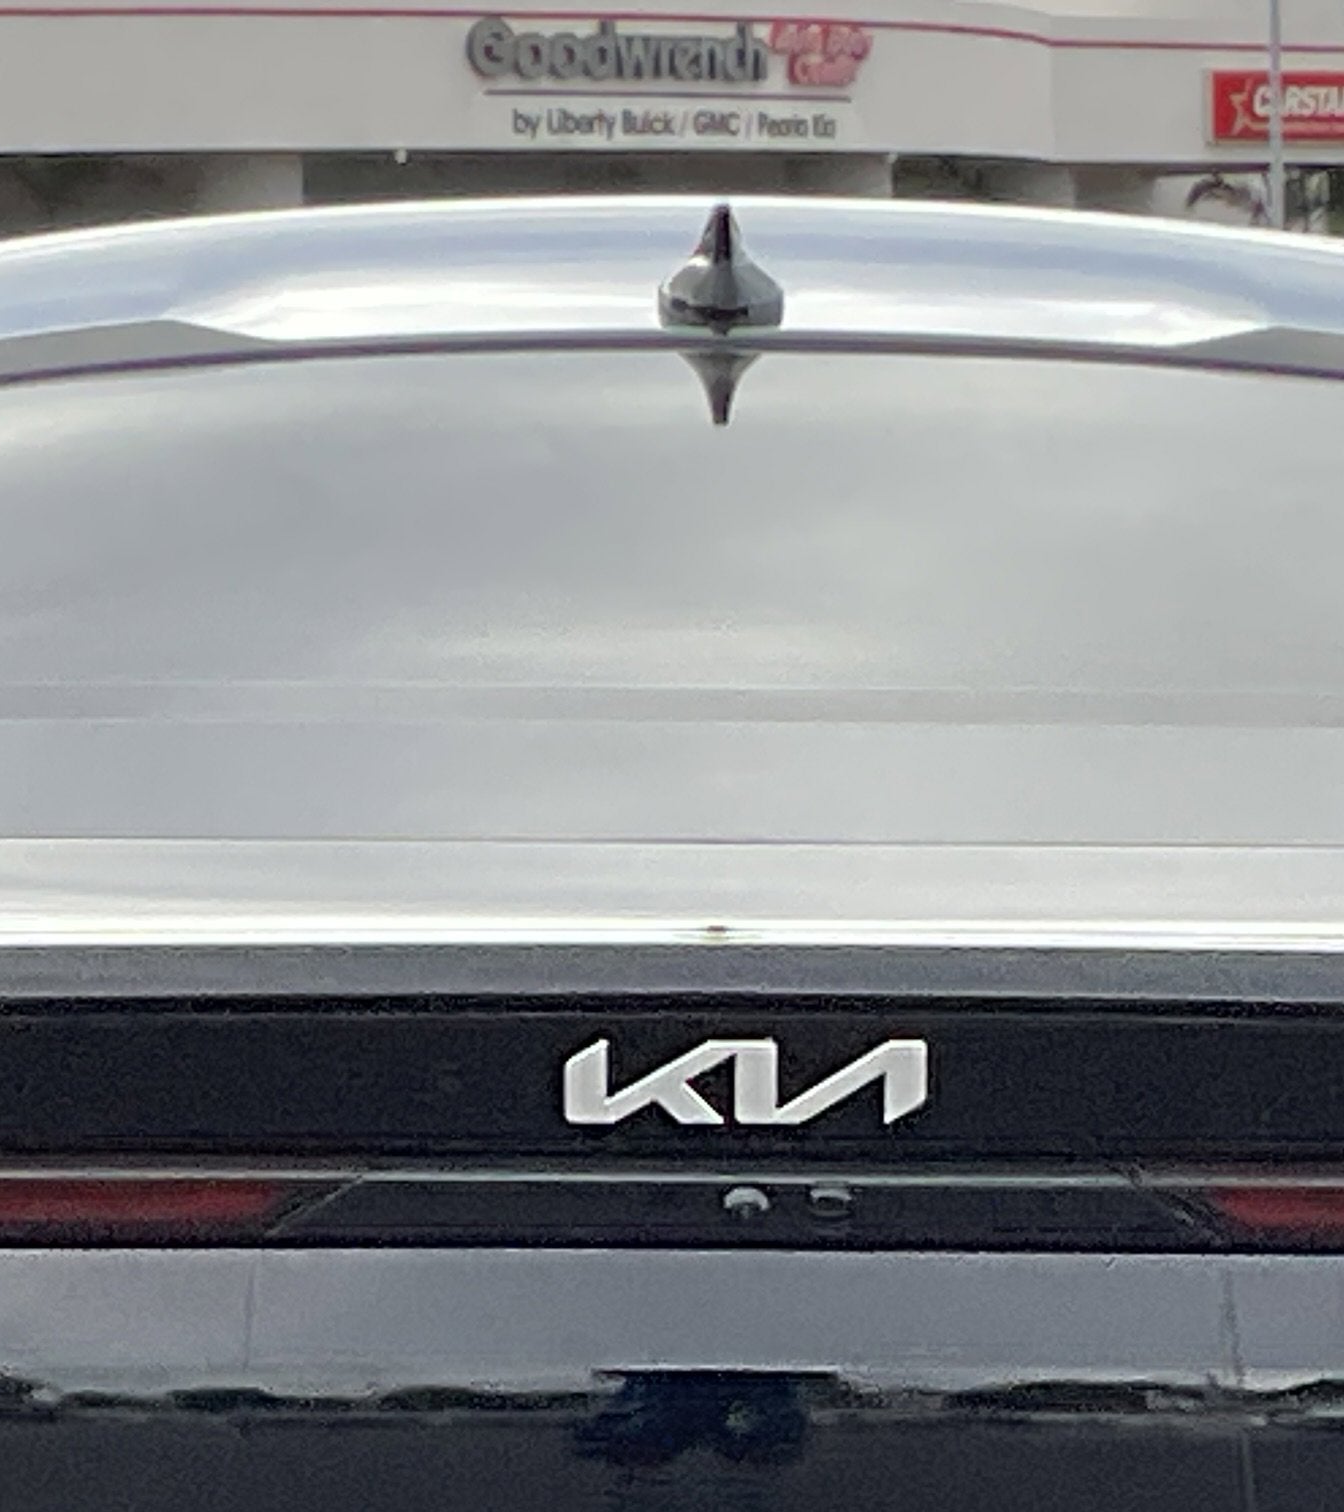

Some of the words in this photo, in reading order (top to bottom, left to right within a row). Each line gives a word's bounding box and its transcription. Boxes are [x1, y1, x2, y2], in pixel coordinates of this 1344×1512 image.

[466, 15, 768, 82] Goodwrench
[512, 108, 541, 139] by
[546, 108, 616, 141] Liberty
[622, 108, 676, 136] Buick
[693, 111, 741, 137] GMC
[564, 1038, 928, 1125] KIA
